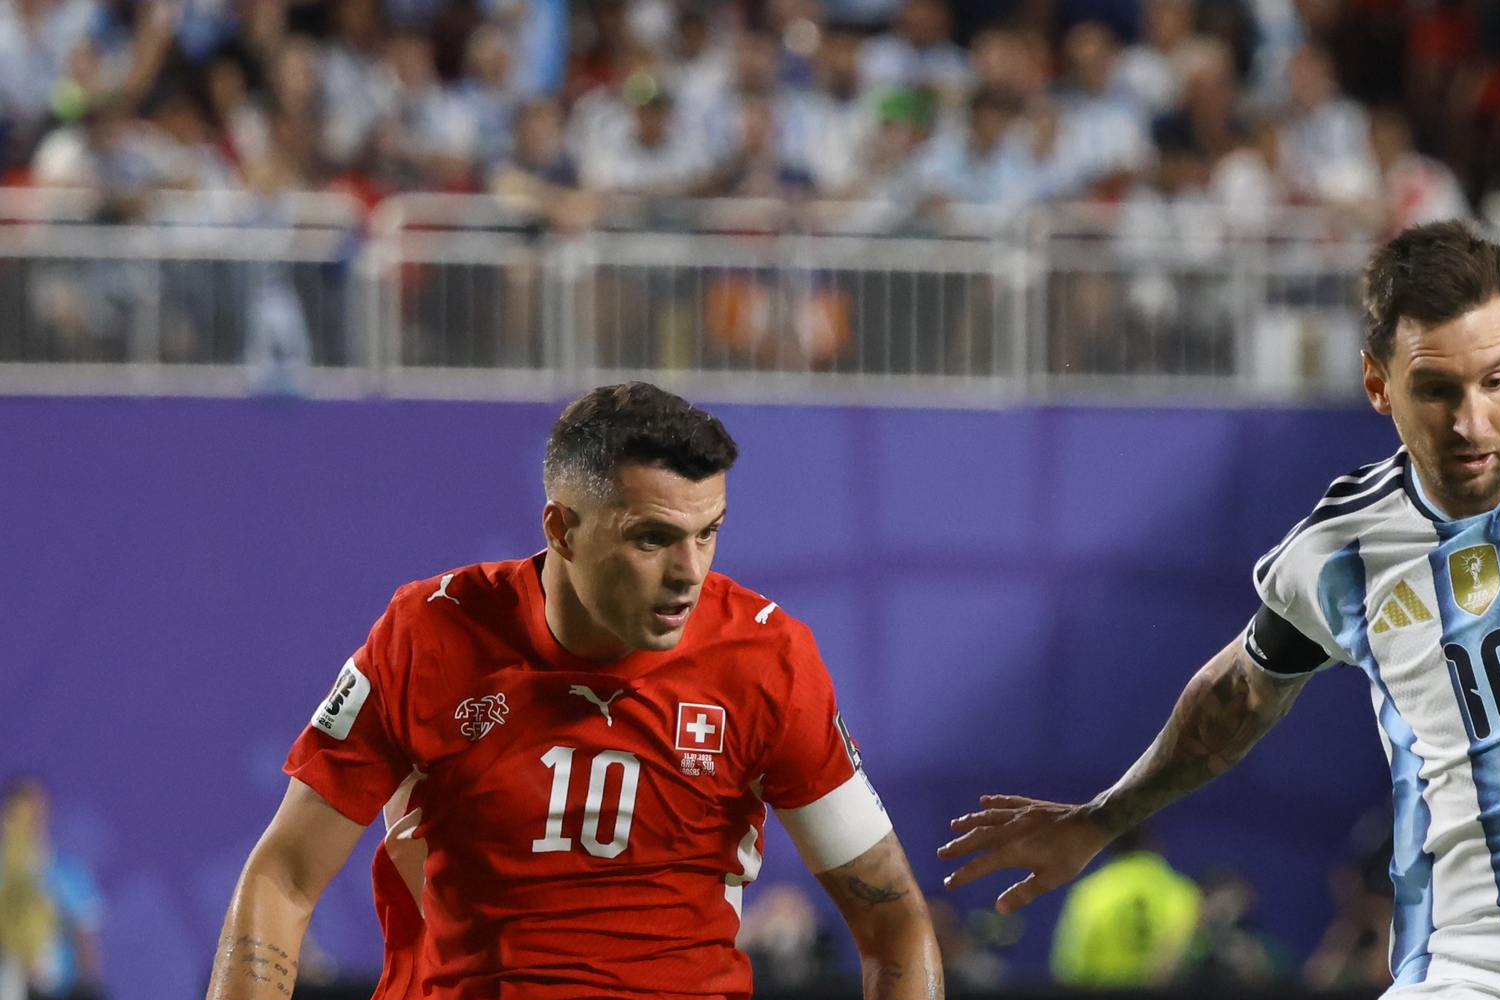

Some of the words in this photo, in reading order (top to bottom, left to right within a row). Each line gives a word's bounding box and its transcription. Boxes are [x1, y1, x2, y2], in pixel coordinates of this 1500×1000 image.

[680, 759, 696, 769] ARG
[702, 760, 715, 771] SUI
[531, 745, 641, 859] 10
